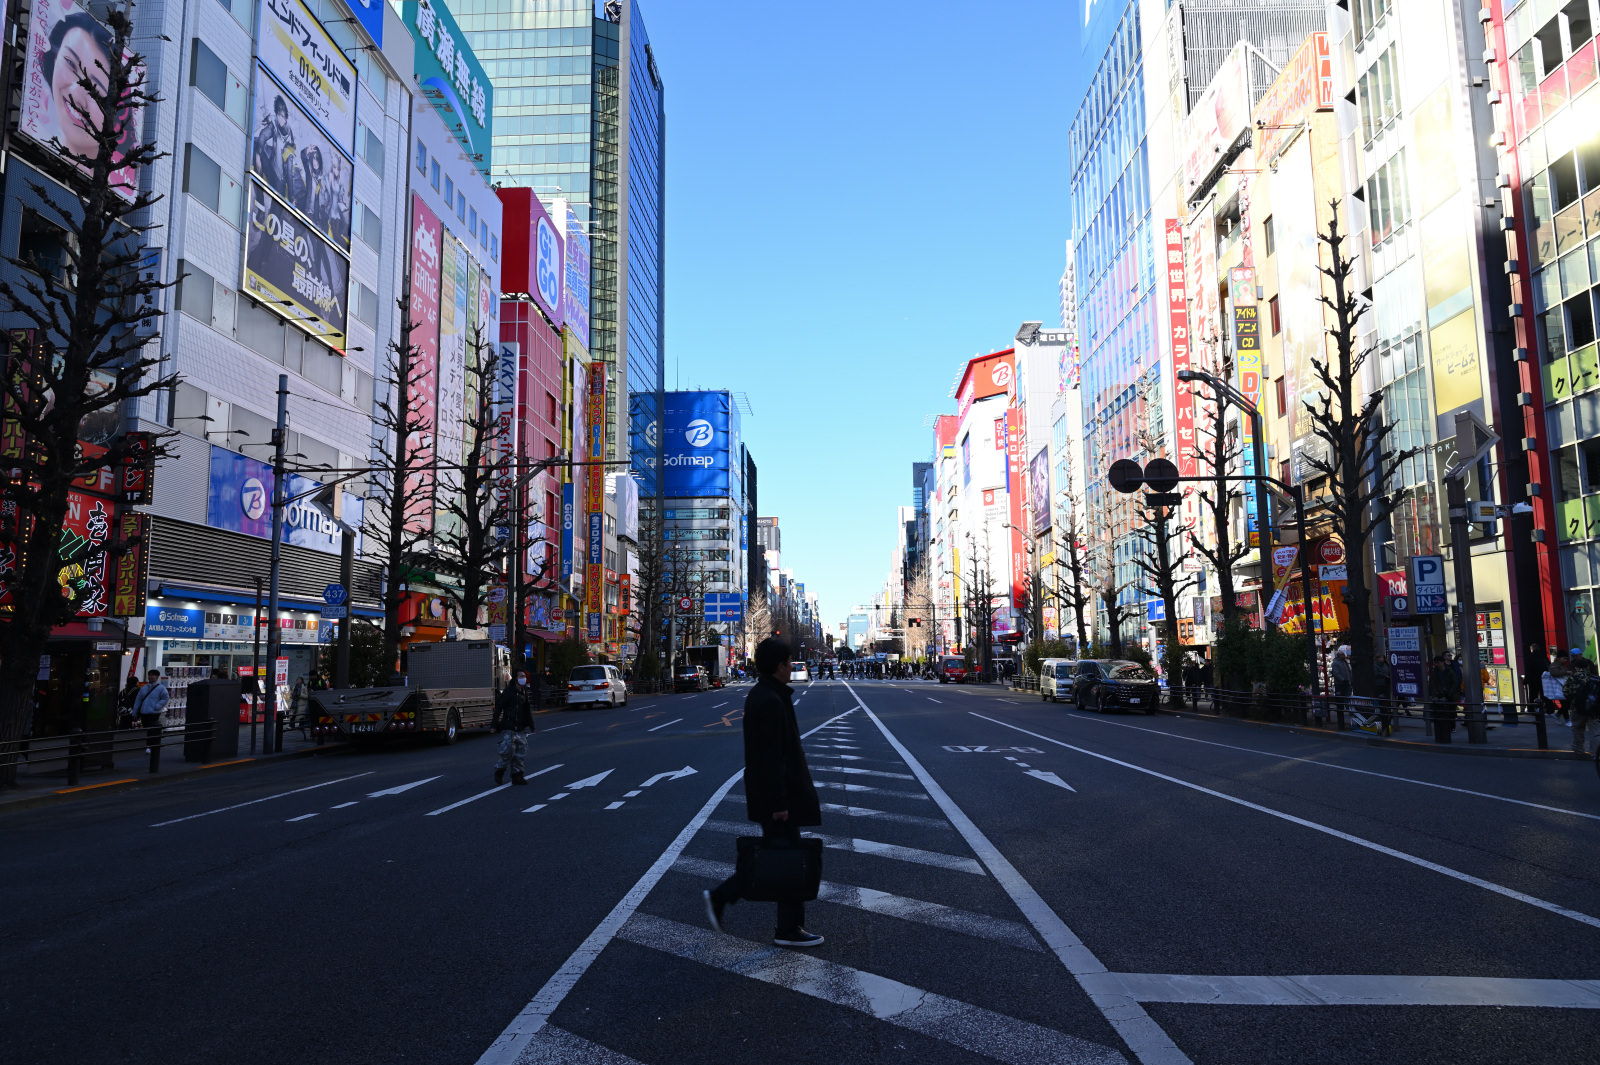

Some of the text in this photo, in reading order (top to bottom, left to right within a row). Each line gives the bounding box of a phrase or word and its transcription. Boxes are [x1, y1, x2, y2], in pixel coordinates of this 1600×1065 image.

[299, 56, 322, 97] 01.22
[1237, 322, 1257, 334] アニメ
[1242, 337, 1254, 348] CD
[1417, 559, 1437, 583] P
[324, 590, 343, 599] 437
[1416, 585, 1444, 595] ダイビル
[1416, 596, 1432, 606] IN
